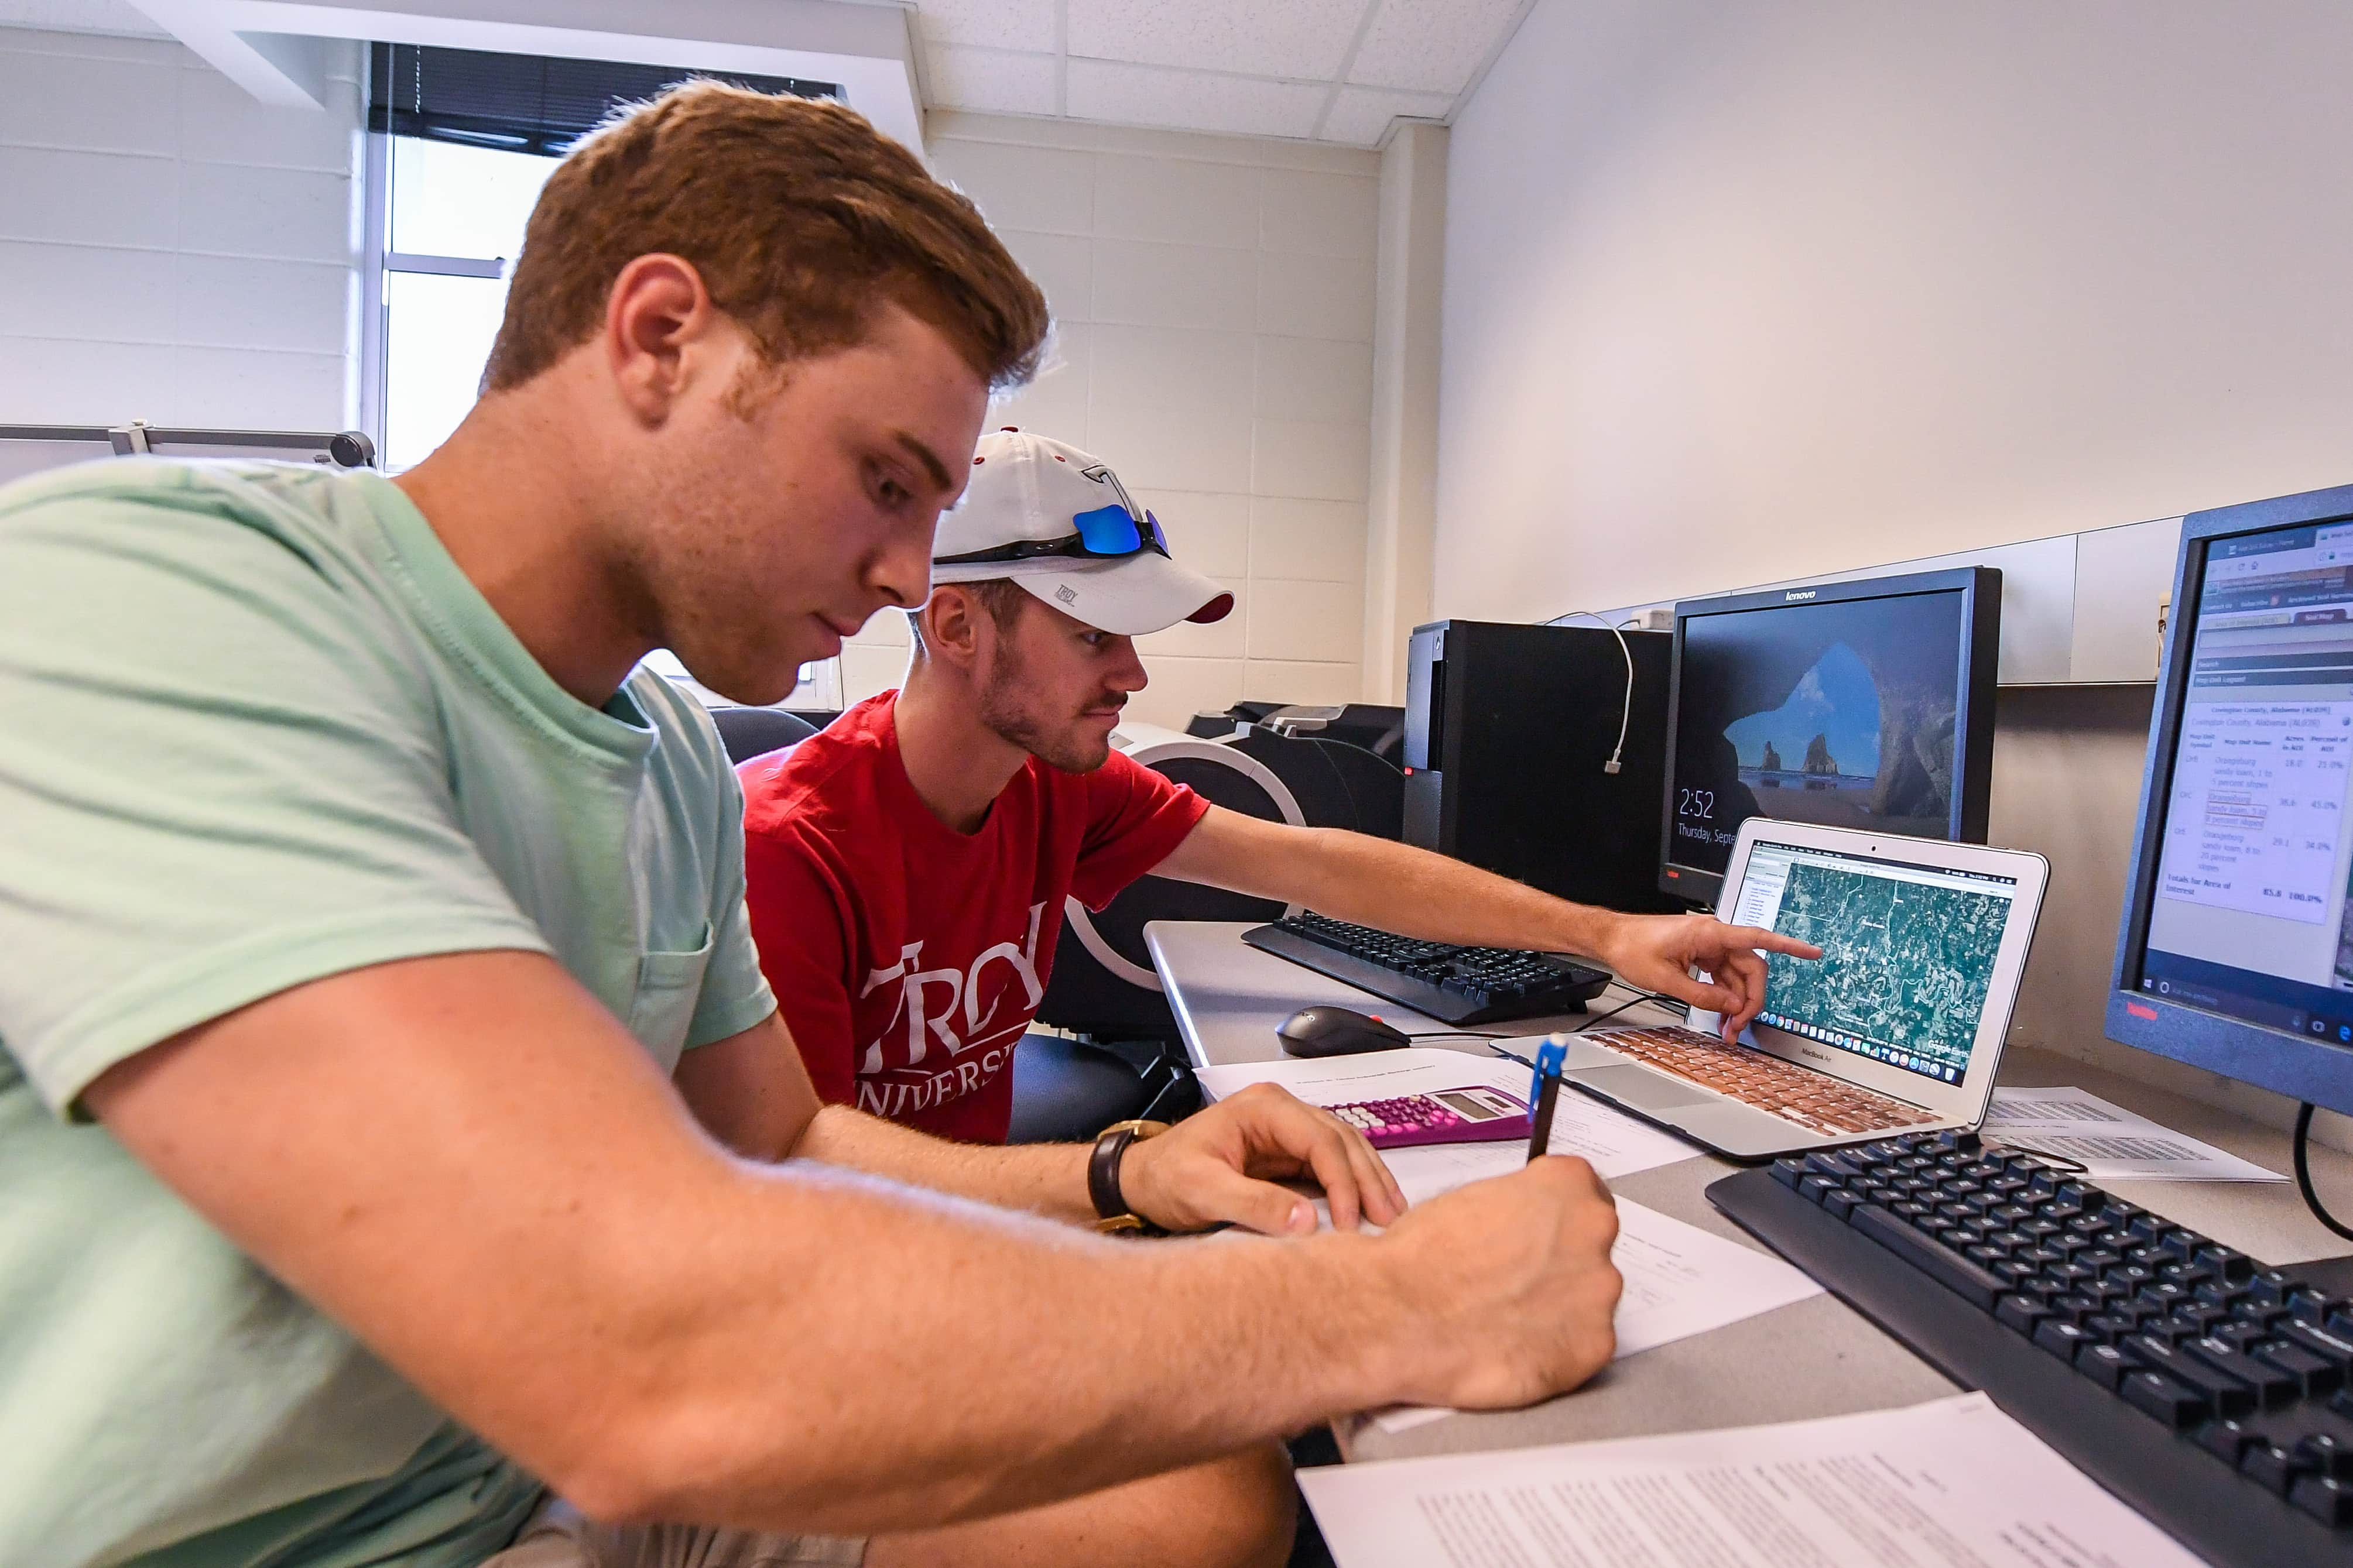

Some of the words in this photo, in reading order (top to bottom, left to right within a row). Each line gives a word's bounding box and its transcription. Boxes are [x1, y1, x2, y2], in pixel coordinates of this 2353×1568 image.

[1057, 584, 1078, 602] TROY
[1786, 591, 1816, 601] lenovo
[1679, 788, 1714, 819] 2:52
[1679, 822, 1712, 844] Thursday,
[859, 900, 1048, 1074] TROY
[1802, 1047, 1824, 1061] MacBook
[1927, 1039, 1951, 1054] Google
[1951, 1047, 1969, 1058] Earth
[855, 1041, 1020, 1117] NIVERSI
